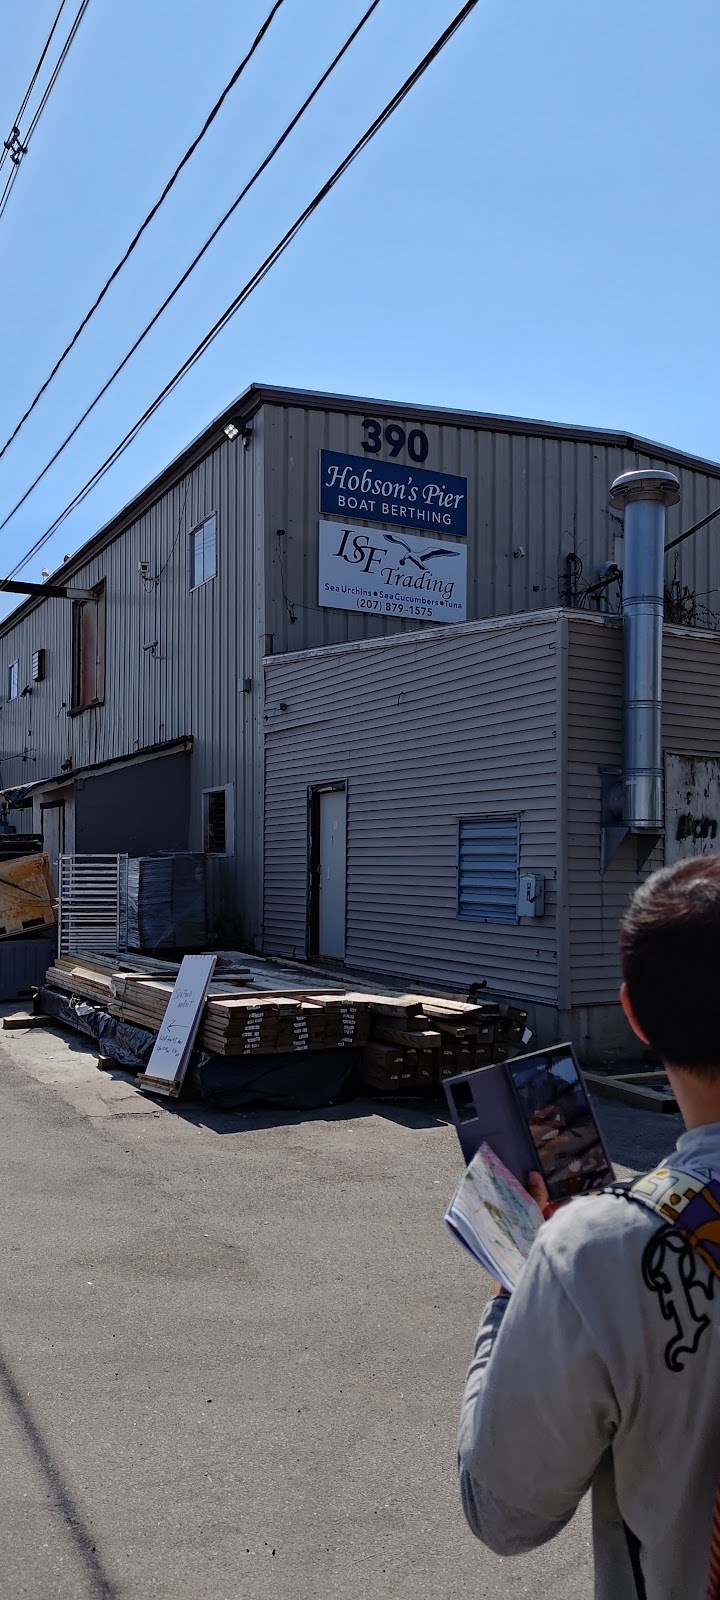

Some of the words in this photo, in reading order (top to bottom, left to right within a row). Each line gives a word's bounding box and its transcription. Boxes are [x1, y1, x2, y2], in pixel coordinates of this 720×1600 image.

[361, 419, 428, 462] 390
[325, 465, 418, 501] Hobson's
[422, 483, 464, 509] Pier
[338, 495, 376, 512] BOAT
[381, 503, 452, 526] BERTHING
[332, 529, 388, 574] ISF
[324, 582, 340, 593] Sea
[444, 600, 463, 609] Tuna
[380, 567, 455, 600] Trading
[356, 597, 383, 611] (207)
[385, 602, 433, 617] 879-1575
